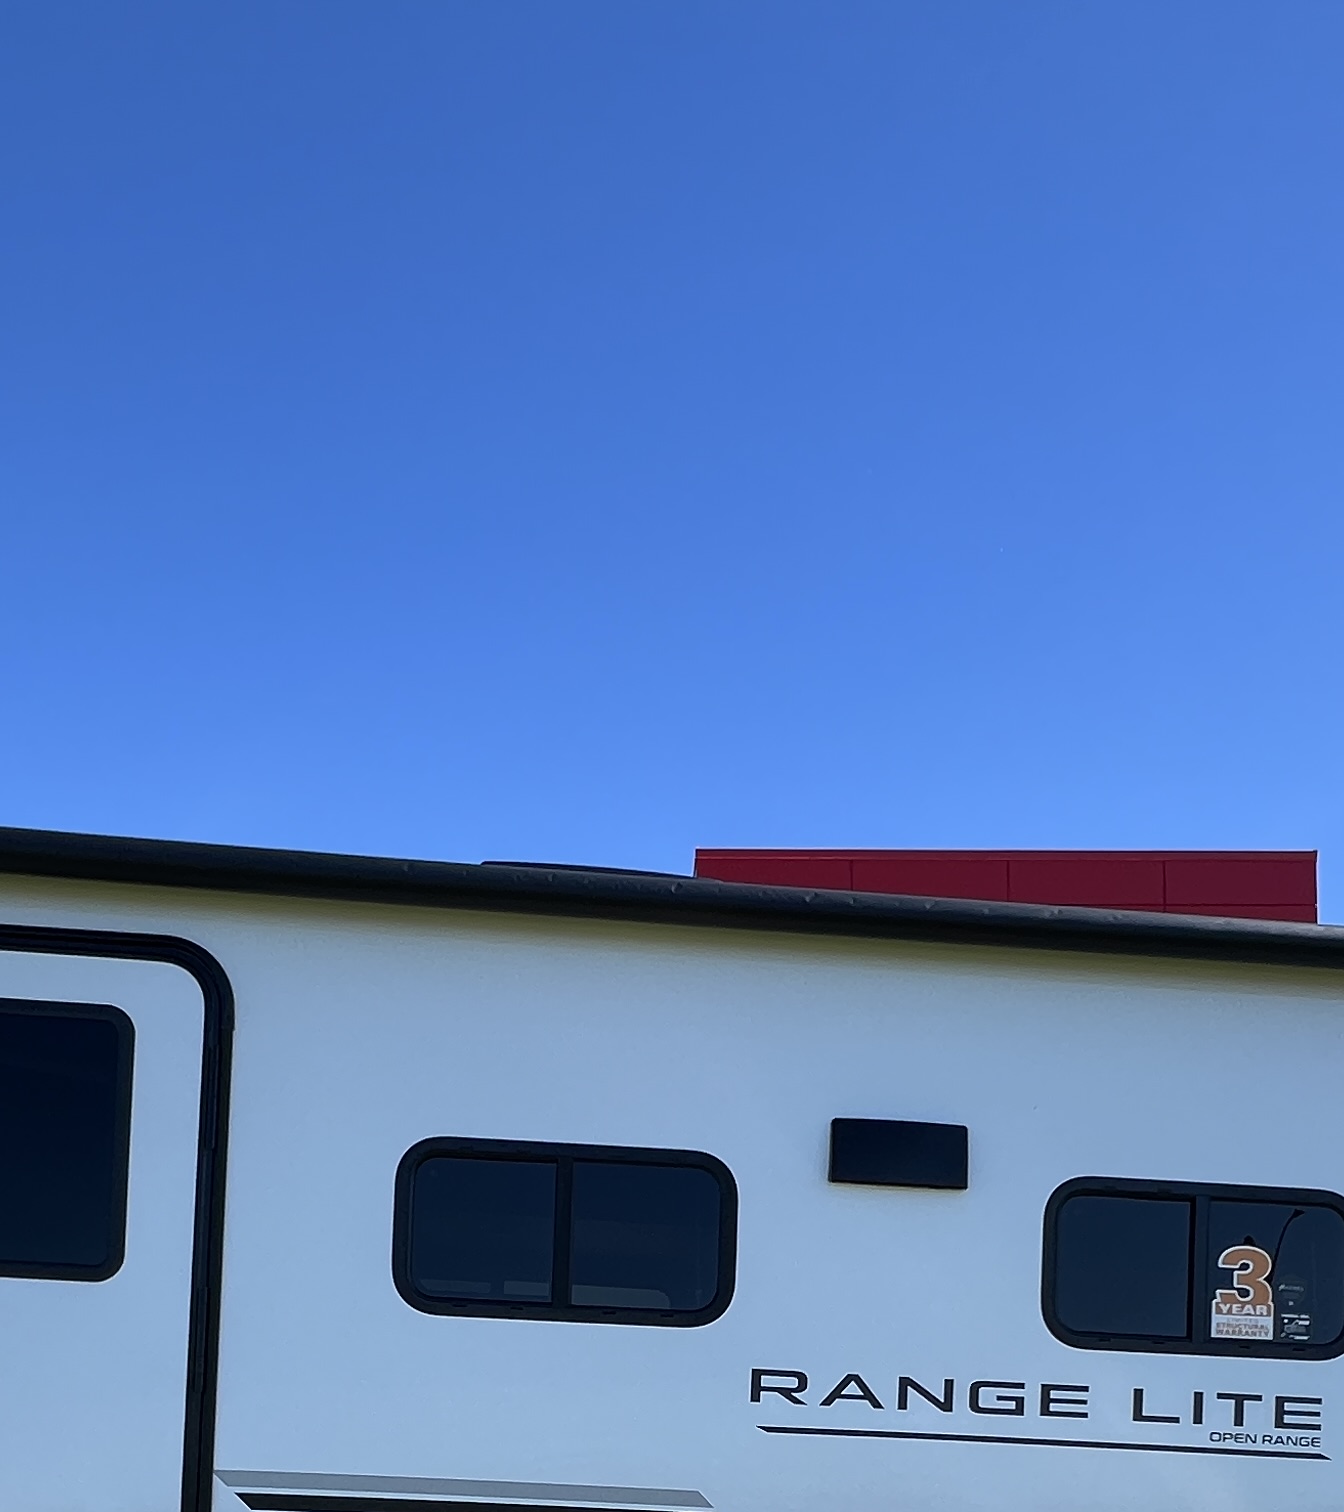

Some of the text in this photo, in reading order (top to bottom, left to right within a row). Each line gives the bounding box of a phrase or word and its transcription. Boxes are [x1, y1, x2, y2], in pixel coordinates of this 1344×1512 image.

[1216, 1246, 1272, 1306] 3
[1218, 1303, 1268, 1316] YEAR
[750, 1368, 1323, 1432] RANGE LITE
[1209, 1431, 1321, 1448] OPEN RANGE
